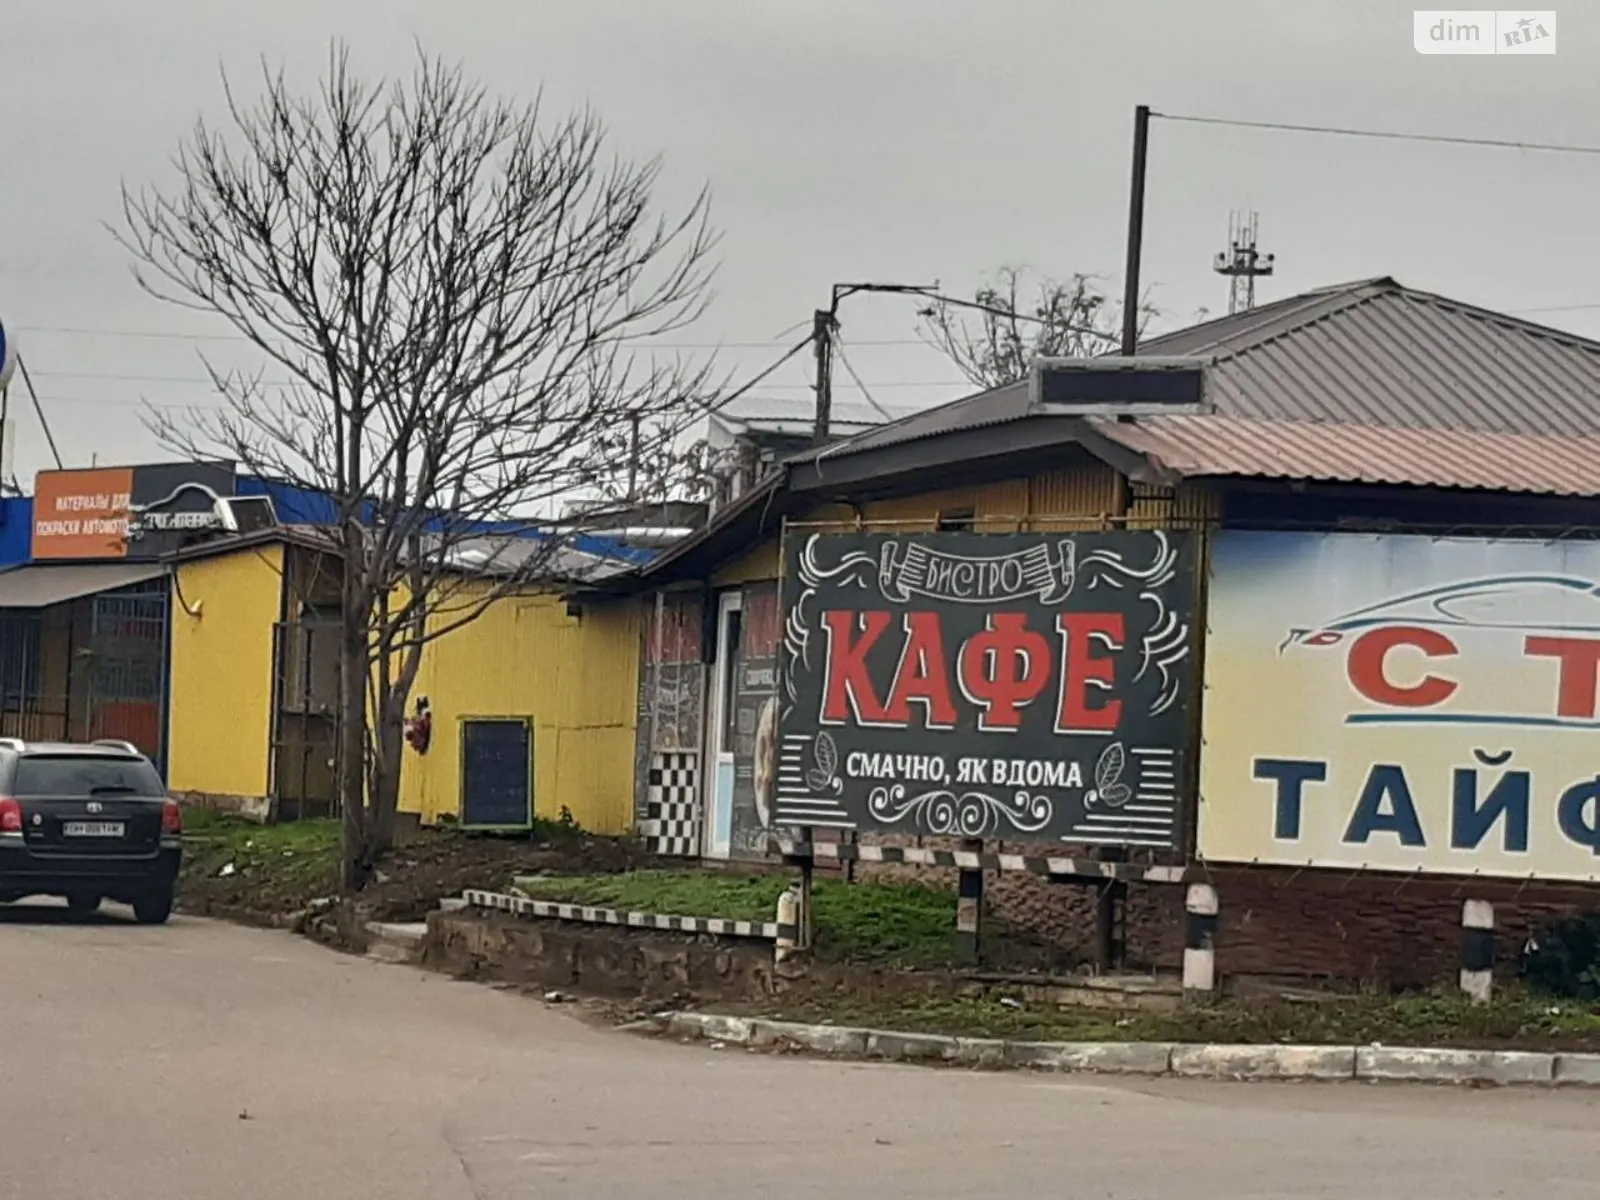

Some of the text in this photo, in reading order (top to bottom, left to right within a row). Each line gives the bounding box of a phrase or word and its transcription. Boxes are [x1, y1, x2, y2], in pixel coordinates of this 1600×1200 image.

[925, 556, 1023, 592] БИСТРО
[819, 610, 1126, 734] КАФЕ
[846, 751, 1084, 789] СМАЧНО, ЯК ВДОМА
